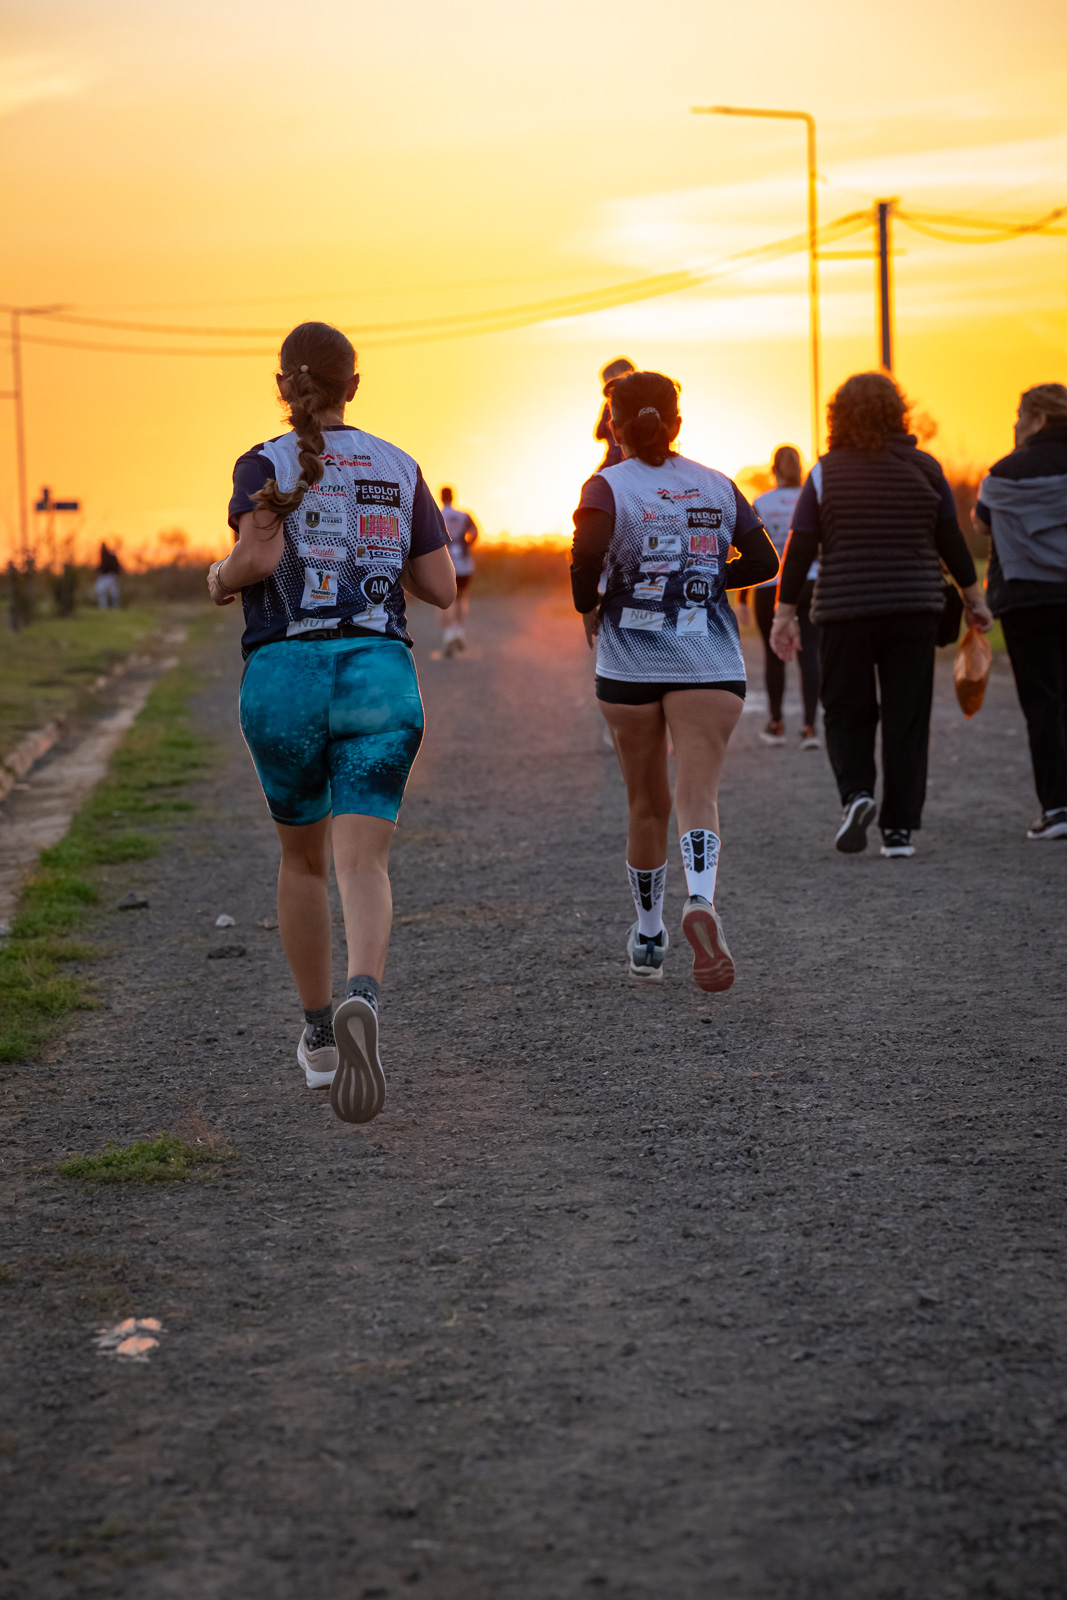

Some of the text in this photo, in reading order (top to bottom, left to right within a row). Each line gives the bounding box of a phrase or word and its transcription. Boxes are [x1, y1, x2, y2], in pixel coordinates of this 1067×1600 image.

[355, 484, 399, 496] FEEDLOT
[687, 511, 722, 520] FEEDLOT
[371, 580, 389, 594] AM
[690, 582, 706, 595] AM
[630, 609, 655, 620] NUT
[298, 618, 328, 629] NUT
